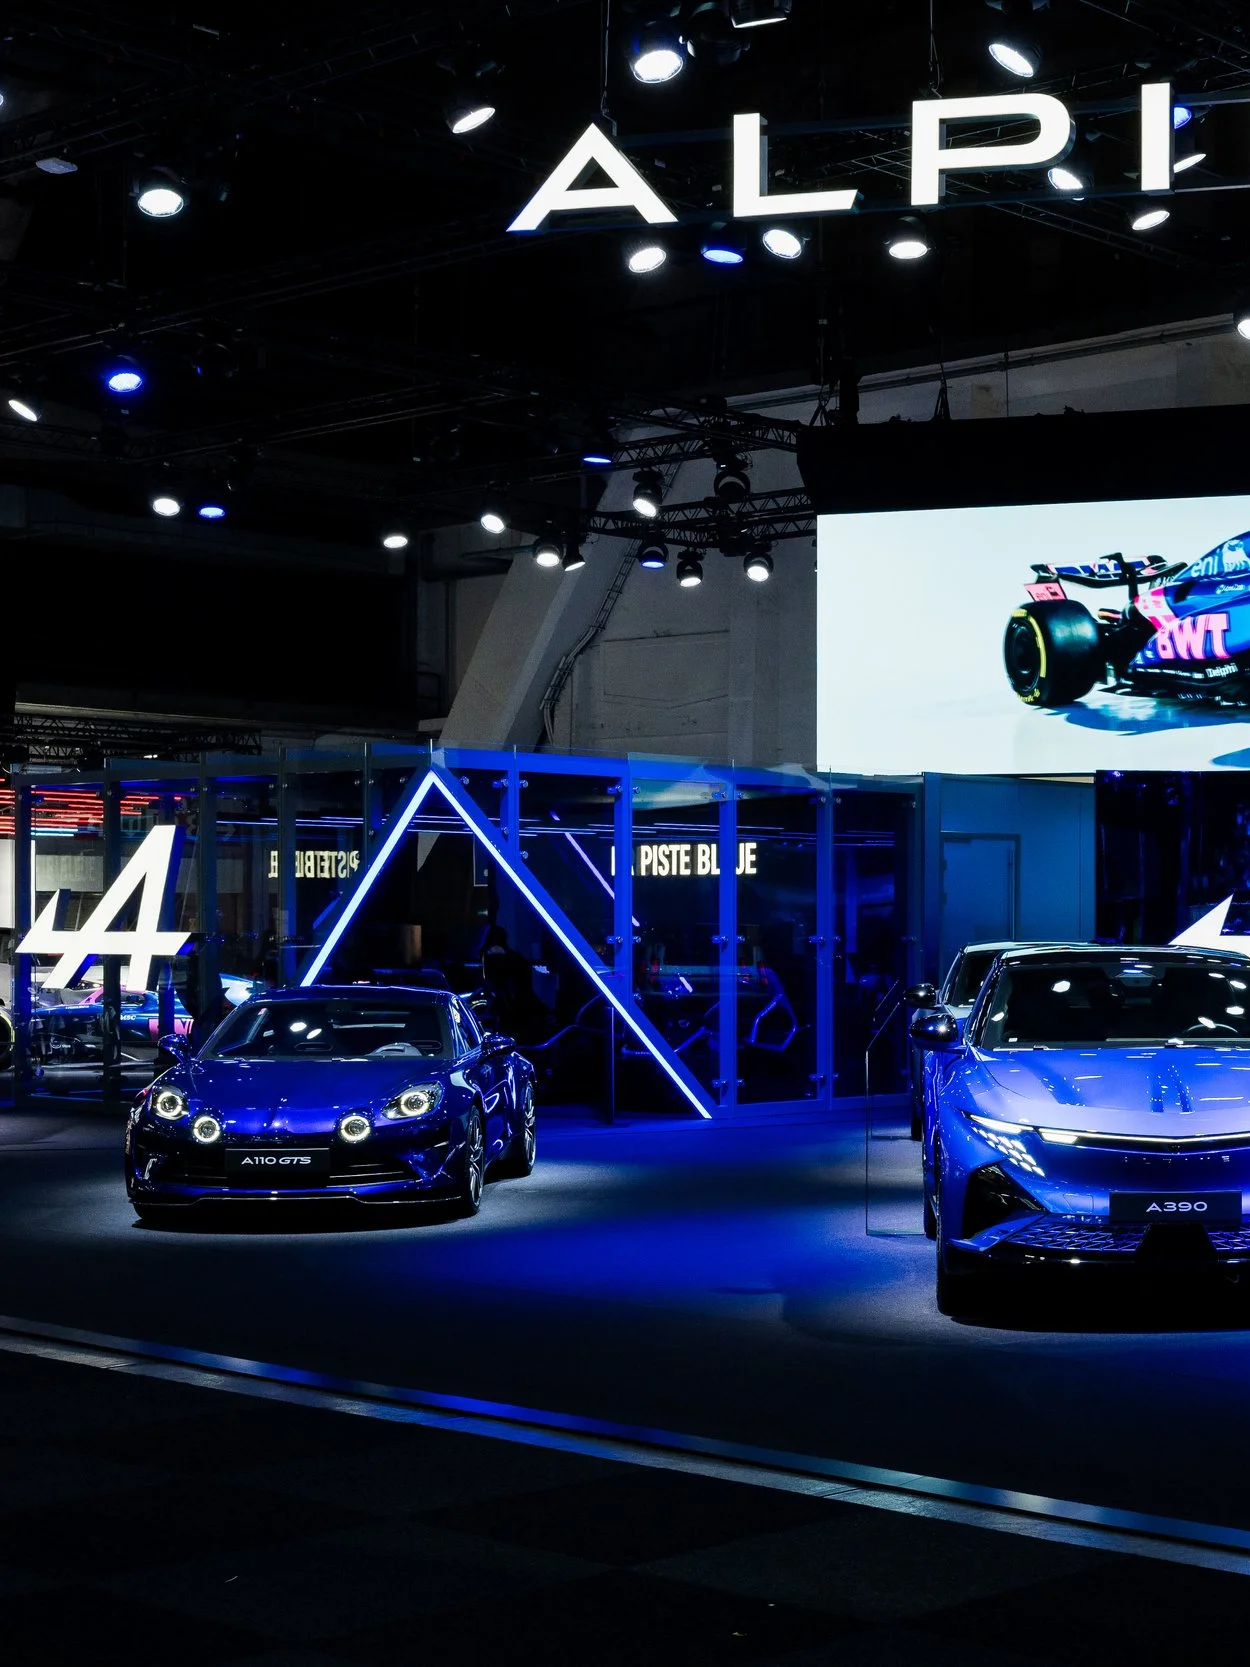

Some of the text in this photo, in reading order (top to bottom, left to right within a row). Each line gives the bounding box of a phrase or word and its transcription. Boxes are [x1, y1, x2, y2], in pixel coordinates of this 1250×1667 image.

[1190, 548, 1220, 578] eni
[1157, 613, 1231, 660] BWT
[1205, 662, 1239, 678] Delphi
[640, 844, 691, 876] PISTE
[697, 842, 757, 875] BLUE
[241, 1156, 312, 1165] A110 GTS
[1145, 1201, 1208, 1213] A390
